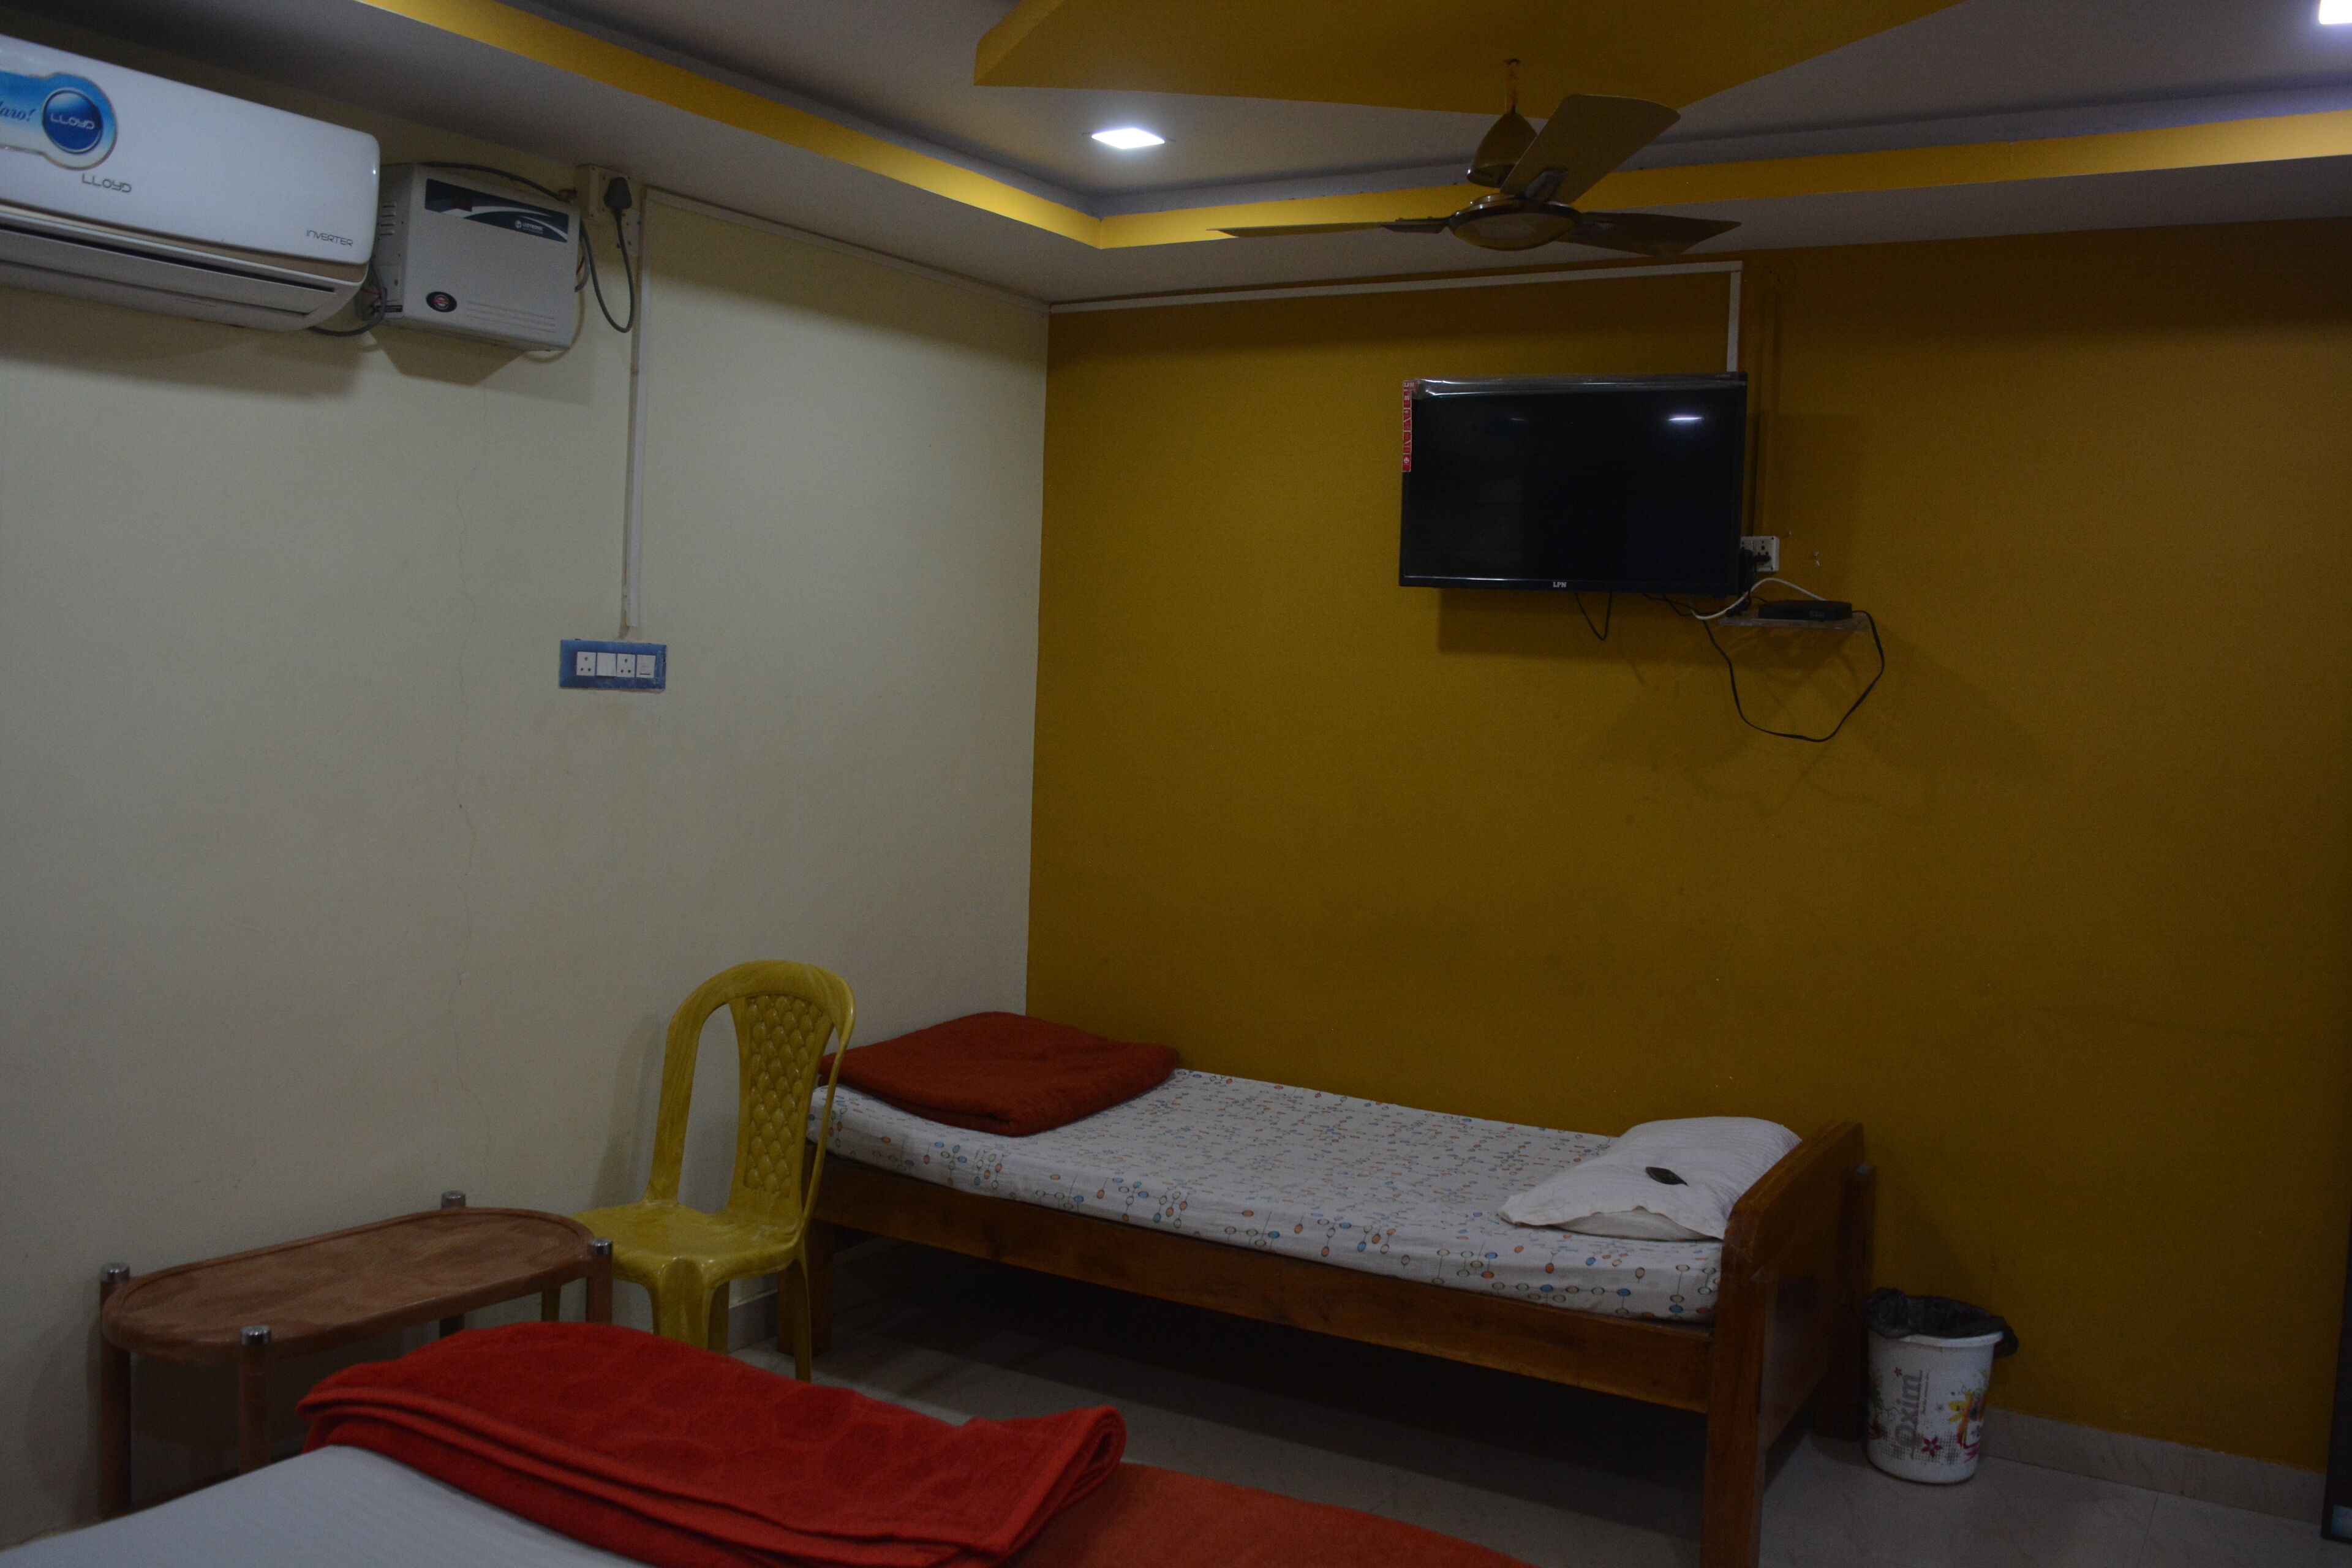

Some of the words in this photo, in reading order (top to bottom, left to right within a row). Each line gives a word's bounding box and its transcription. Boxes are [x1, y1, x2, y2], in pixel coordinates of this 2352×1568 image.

[0, 100, 36, 122] aro!
[50, 113, 95, 130] LLOYD
[81, 173, 132, 193] LLOYD
